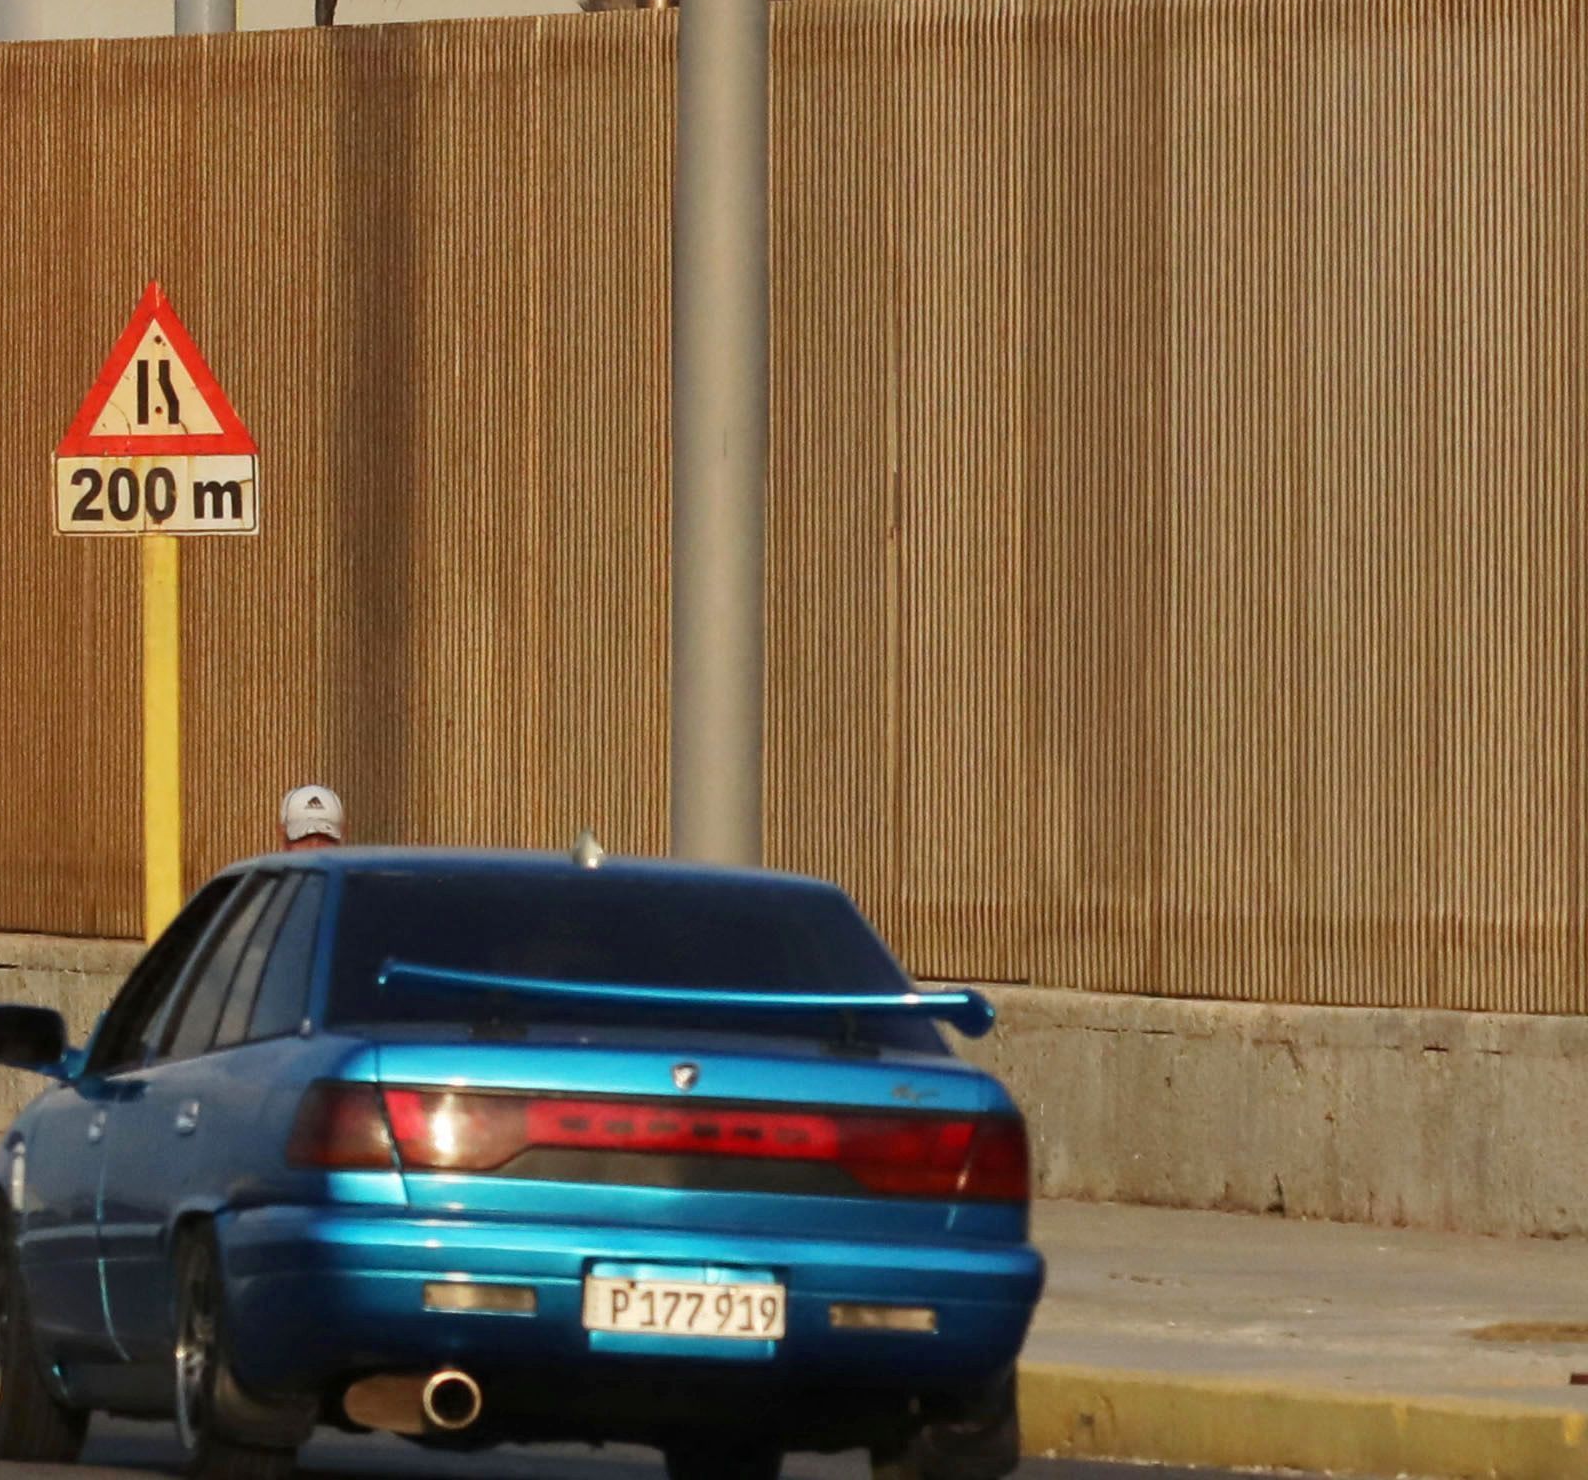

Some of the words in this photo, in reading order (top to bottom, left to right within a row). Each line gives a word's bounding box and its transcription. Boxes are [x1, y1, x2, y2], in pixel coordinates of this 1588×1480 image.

[70, 467, 177, 522] 200
[193, 481, 243, 520] m
[611, 1289, 629, 1324] P
[639, 1291, 704, 1328] 177
[715, 1293, 777, 1332] 919
